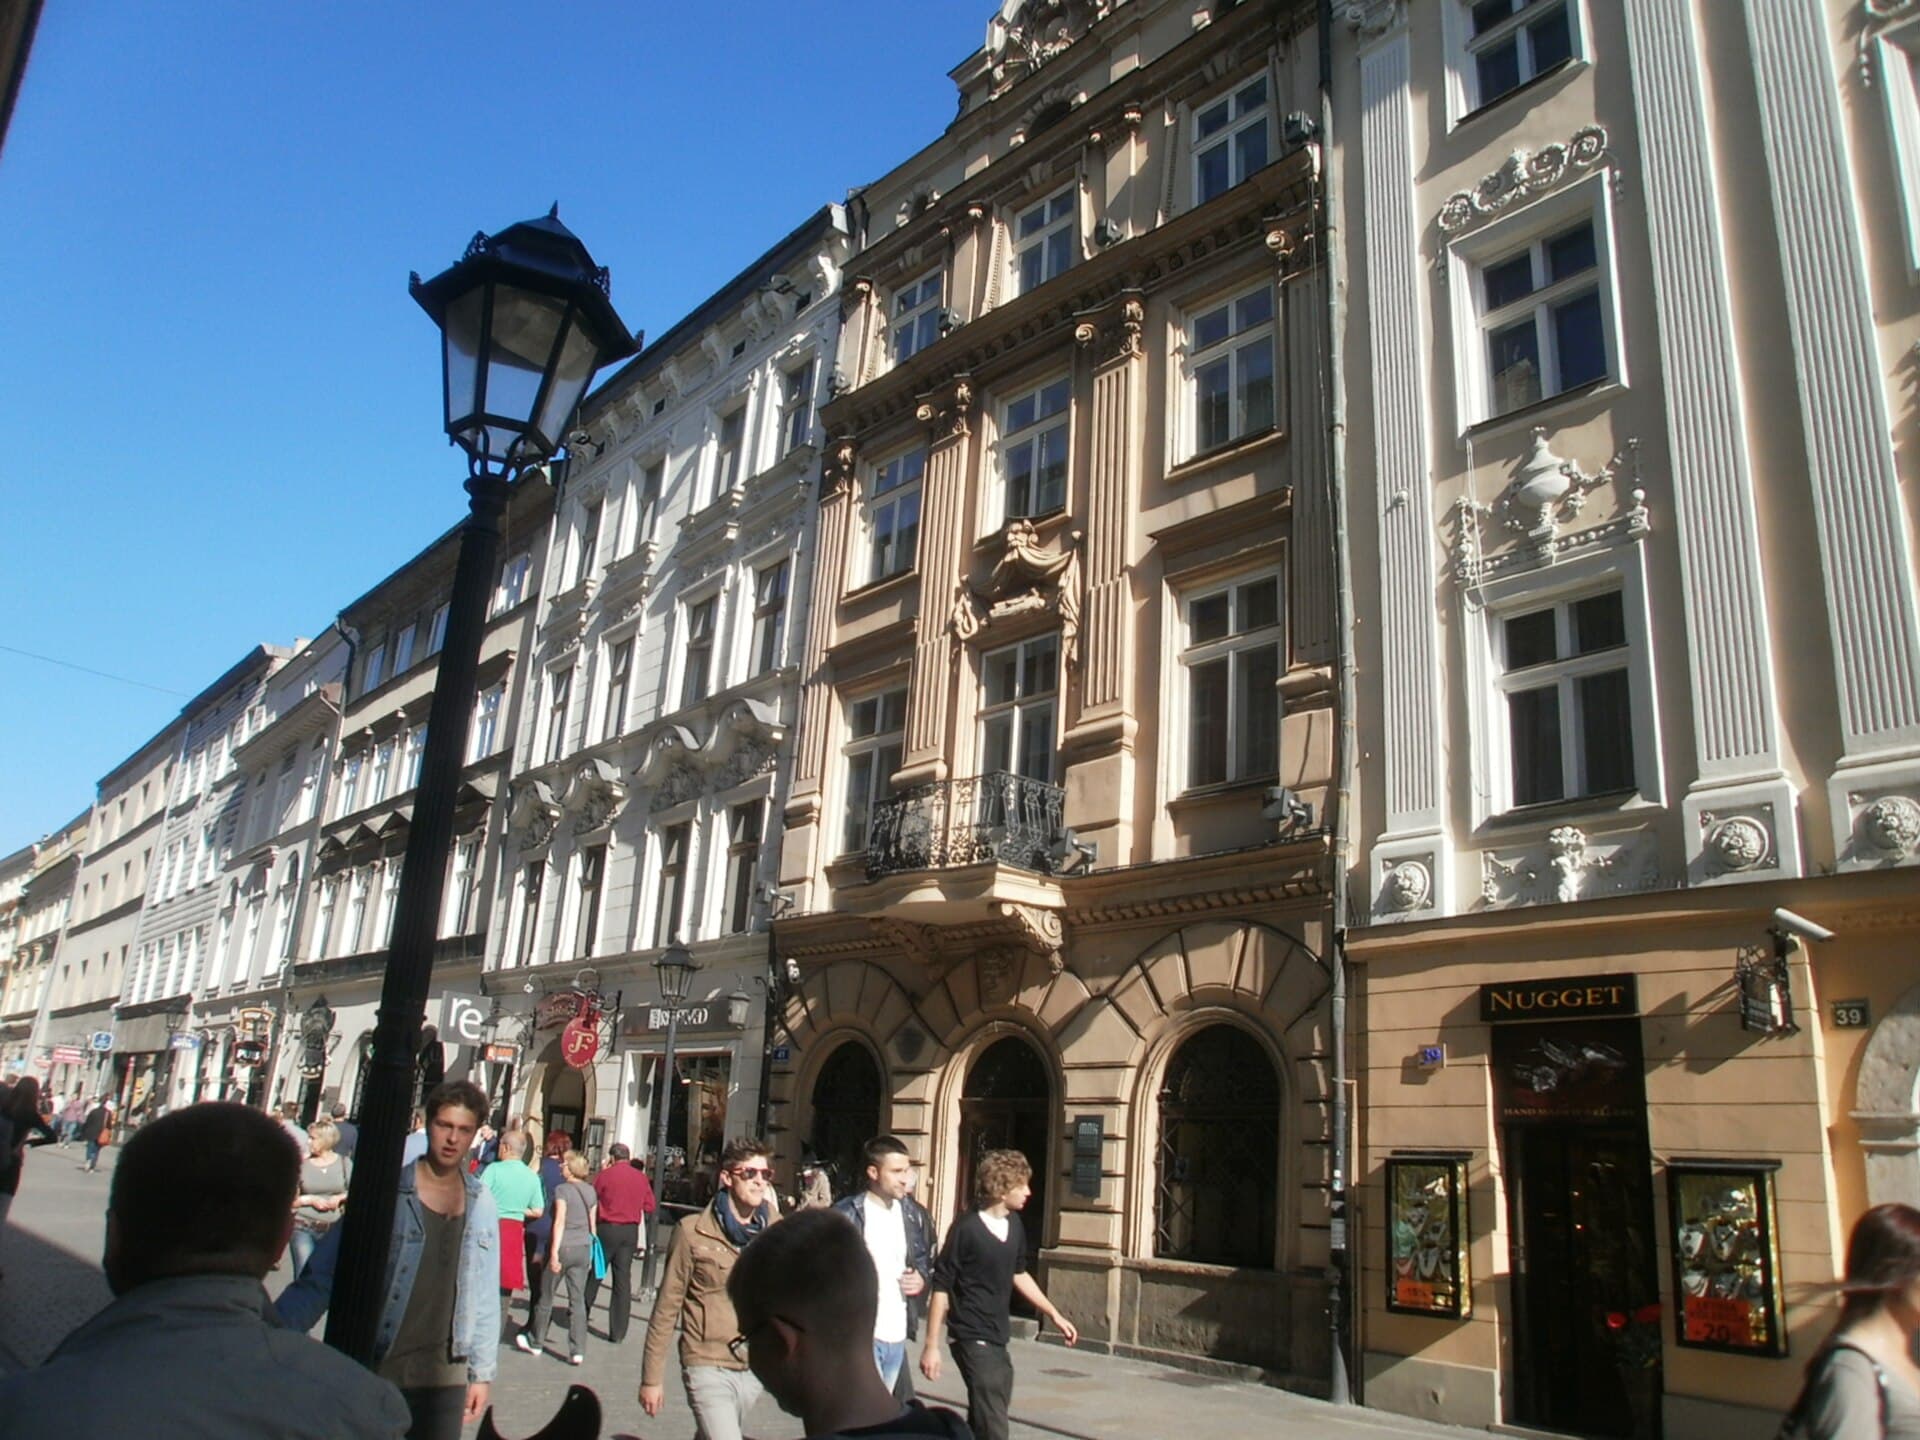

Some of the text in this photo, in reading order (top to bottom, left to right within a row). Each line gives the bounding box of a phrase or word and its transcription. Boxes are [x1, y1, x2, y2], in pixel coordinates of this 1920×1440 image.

[1490, 986, 1623, 1011] NUGGET
[449, 997, 483, 1039] re
[1836, 1008, 1861, 1025] 39
